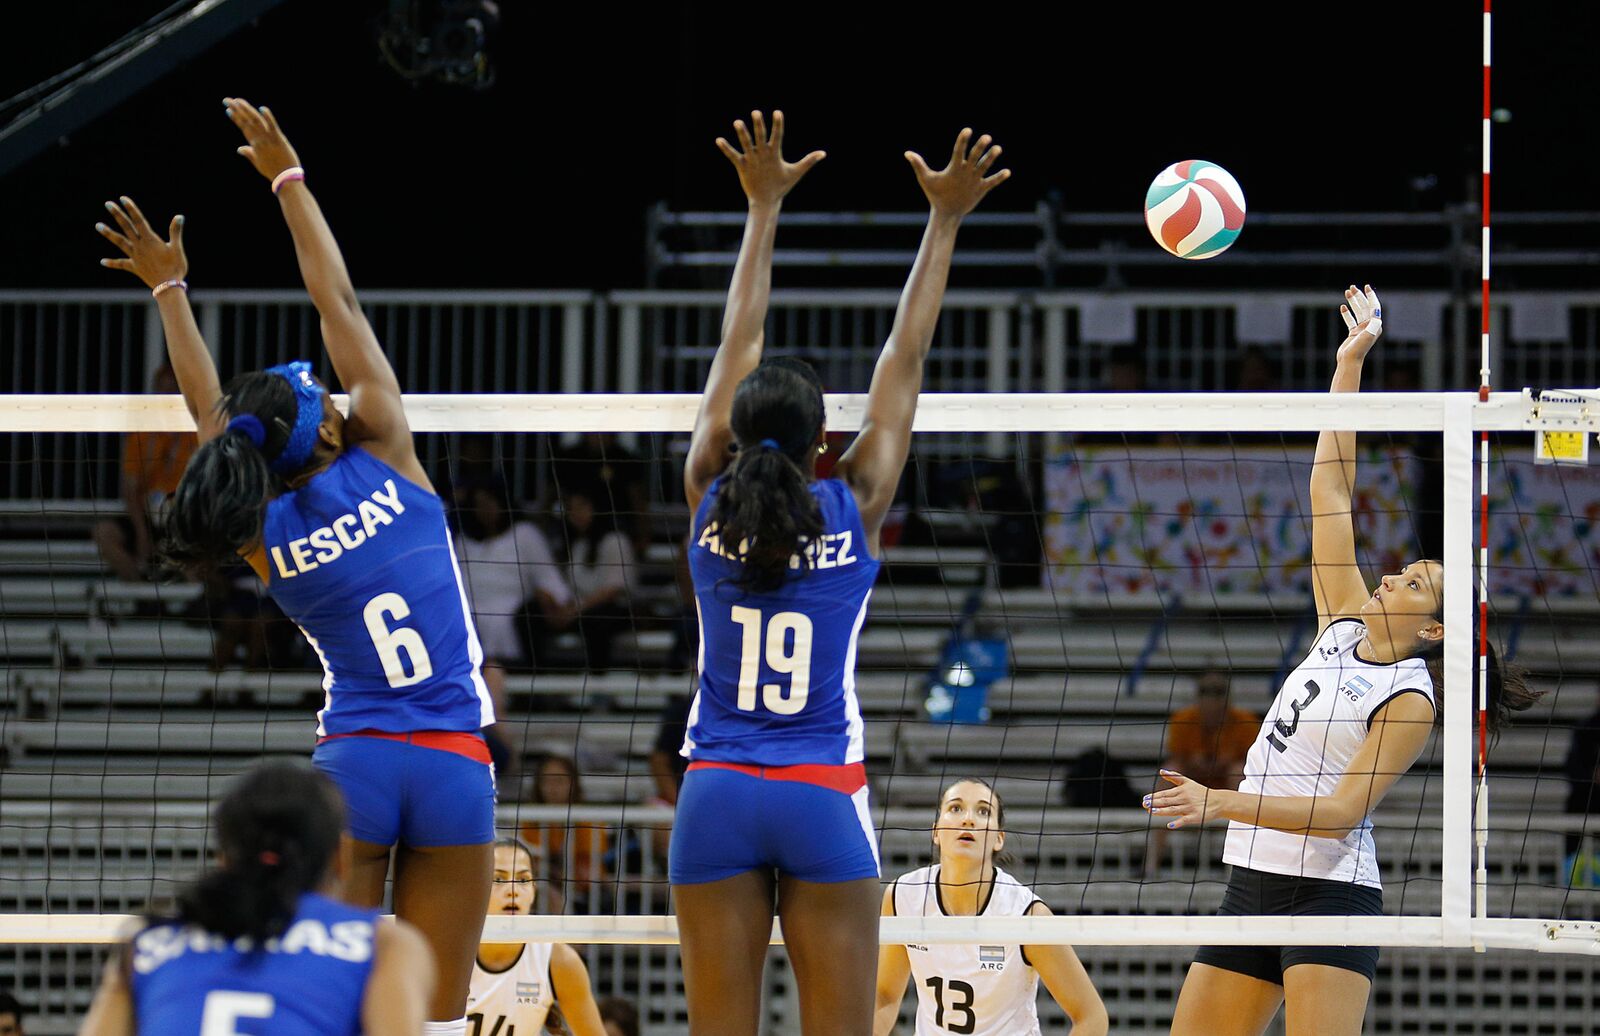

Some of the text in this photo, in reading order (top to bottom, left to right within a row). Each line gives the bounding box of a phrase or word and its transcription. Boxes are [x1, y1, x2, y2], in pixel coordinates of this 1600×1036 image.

[1541, 395, 1586, 404] Senoh
[270, 478, 406, 579] LESCAY
[362, 591, 433, 689] 6
[730, 604, 814, 716] 19
[1339, 685, 1360, 702] ARG
[980, 962, 1005, 971] ARG
[925, 975, 976, 1035] 13
